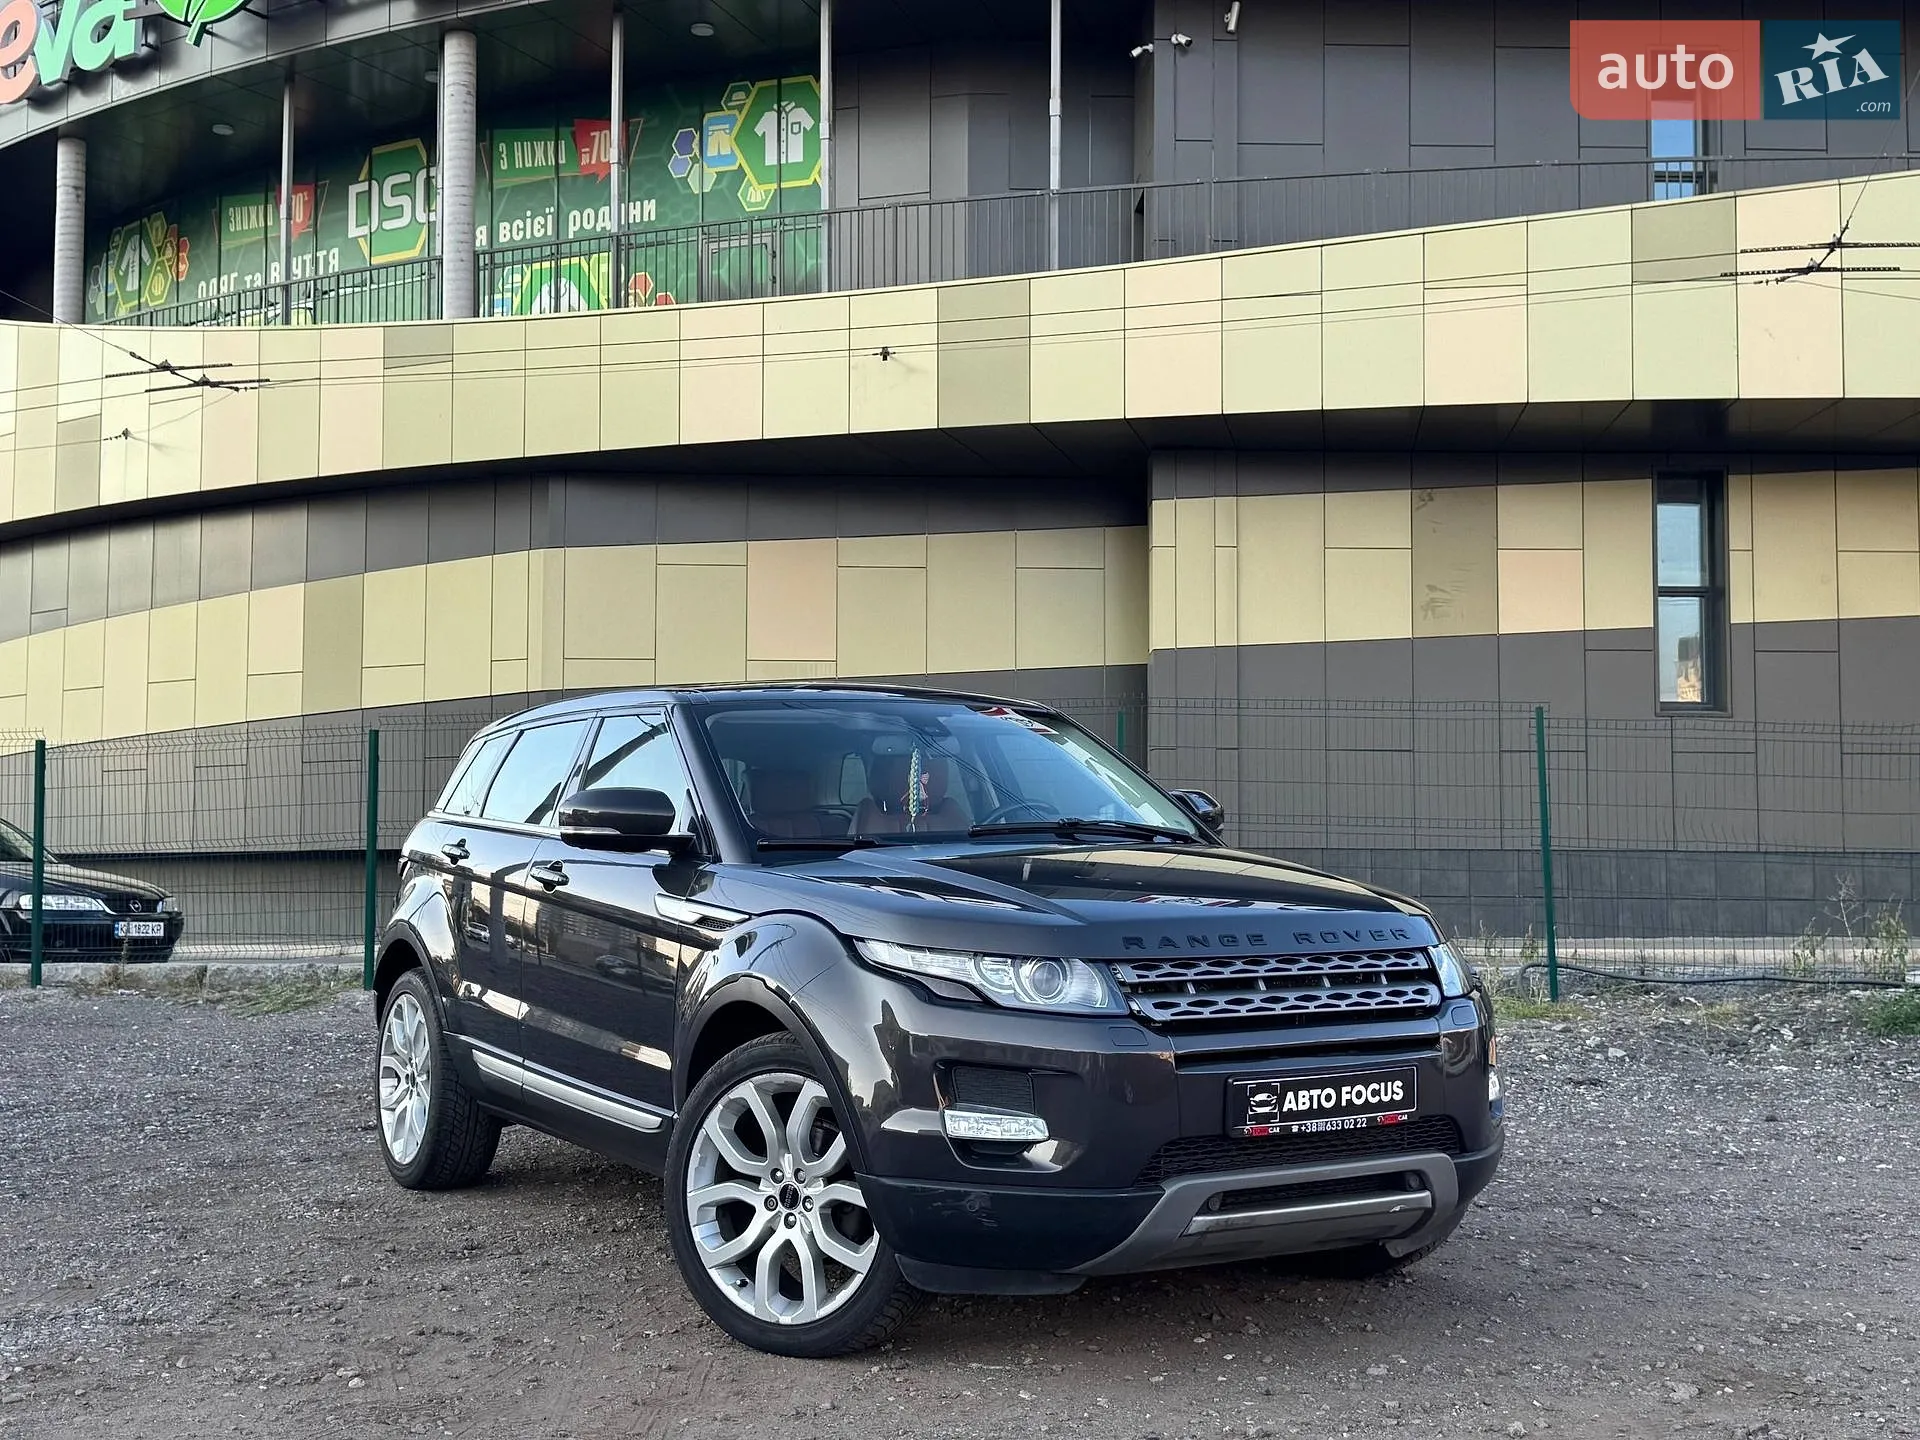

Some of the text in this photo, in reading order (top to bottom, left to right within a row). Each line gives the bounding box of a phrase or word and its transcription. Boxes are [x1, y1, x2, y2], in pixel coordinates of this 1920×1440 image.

[228, 203, 273, 232] ЗНИЖКИ
[499, 206, 555, 243] всієї
[270, 247, 339, 284] ВУТТЯ
[1122, 928, 1410, 951] RANGE ROVER
[1341, 1080, 1404, 1107] FOCUS
